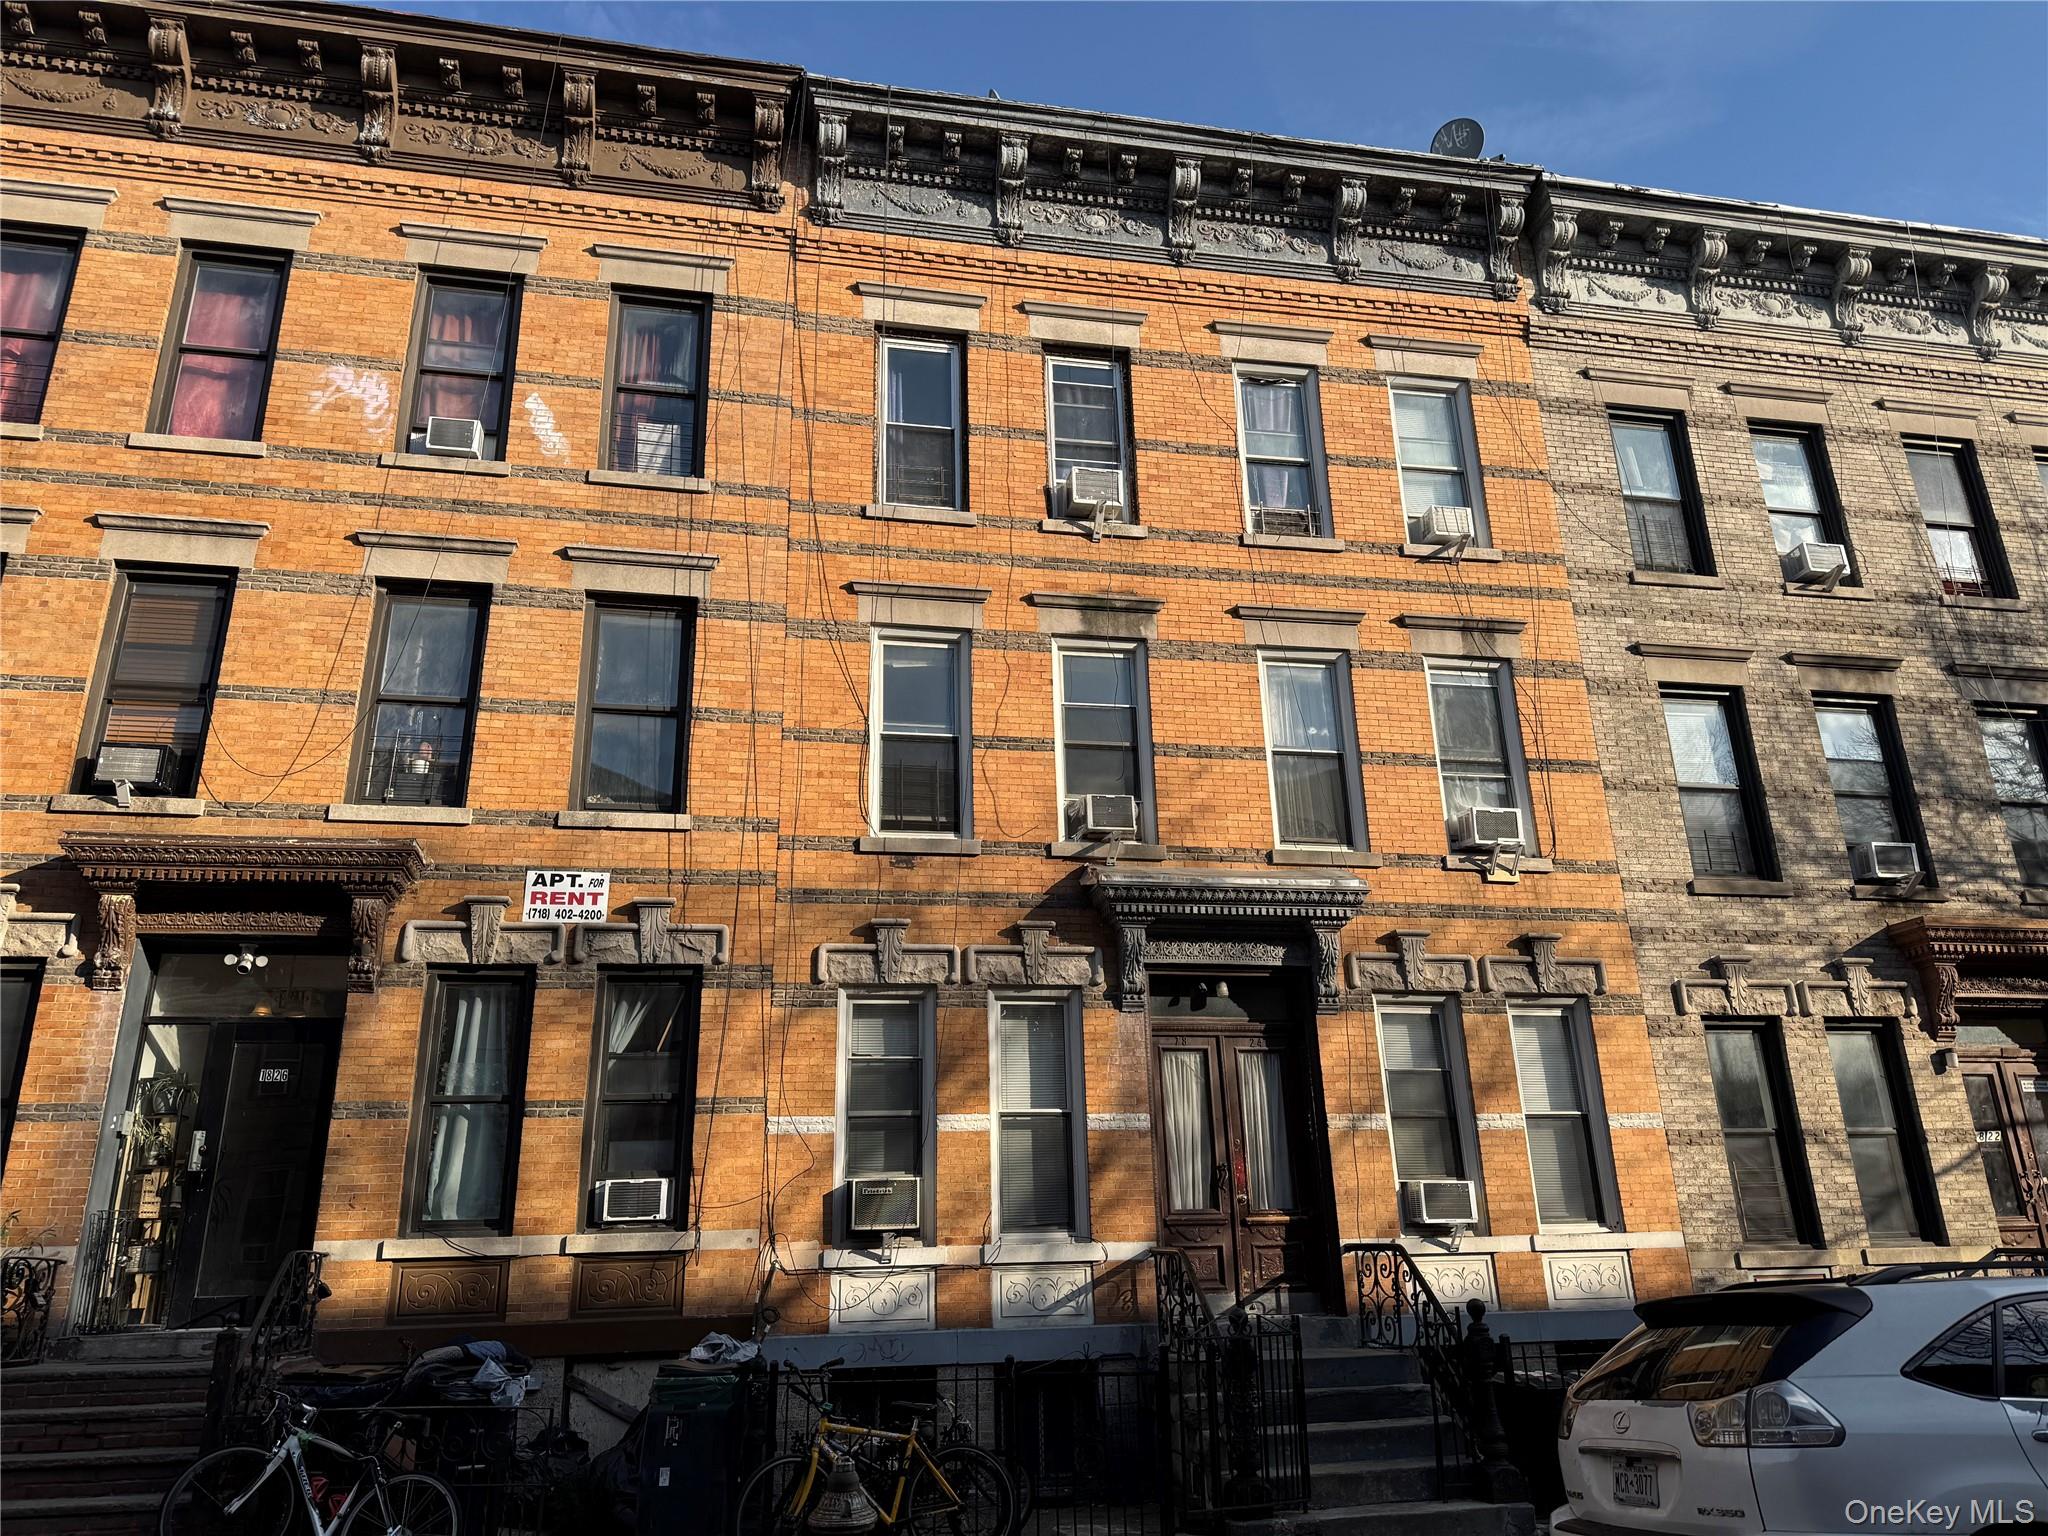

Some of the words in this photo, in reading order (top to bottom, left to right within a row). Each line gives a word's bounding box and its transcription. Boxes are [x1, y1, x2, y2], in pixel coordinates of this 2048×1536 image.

[531, 873, 584, 888] APT.
[588, 878, 605, 888] FOR
[530, 891, 604, 906] RENT
[528, 908, 551, 920] (718)
[555, 909, 603, 920] 402-4200
[259, 1069, 288, 1081] 1826
